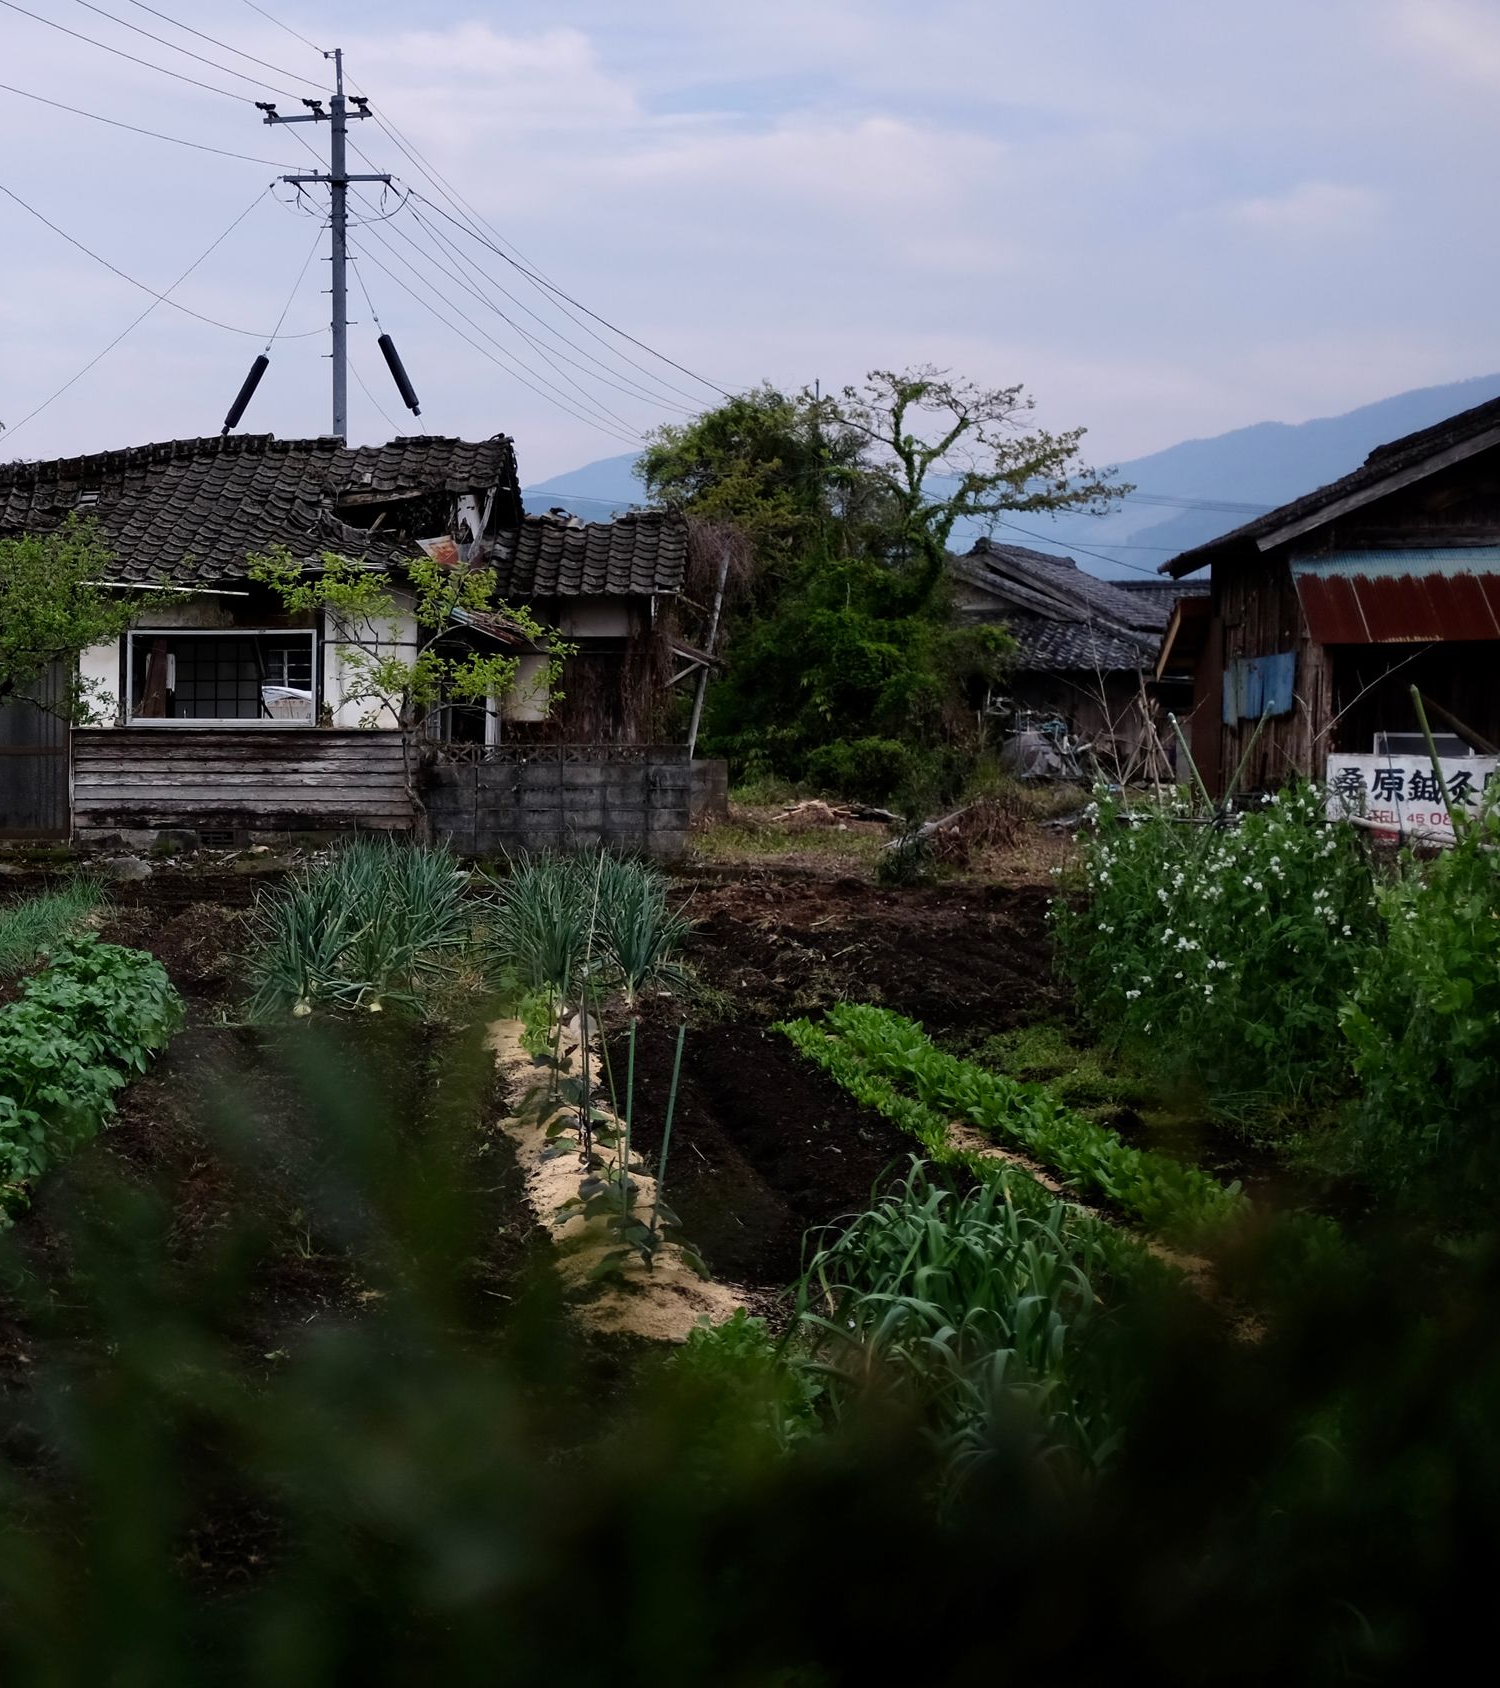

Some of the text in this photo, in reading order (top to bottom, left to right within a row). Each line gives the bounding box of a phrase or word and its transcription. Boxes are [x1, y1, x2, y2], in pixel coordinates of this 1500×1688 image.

[1337, 767, 1493, 806] 桑原鍼灸
[1370, 810, 1400, 824] TEL
[1406, 813, 1425, 824] 45
